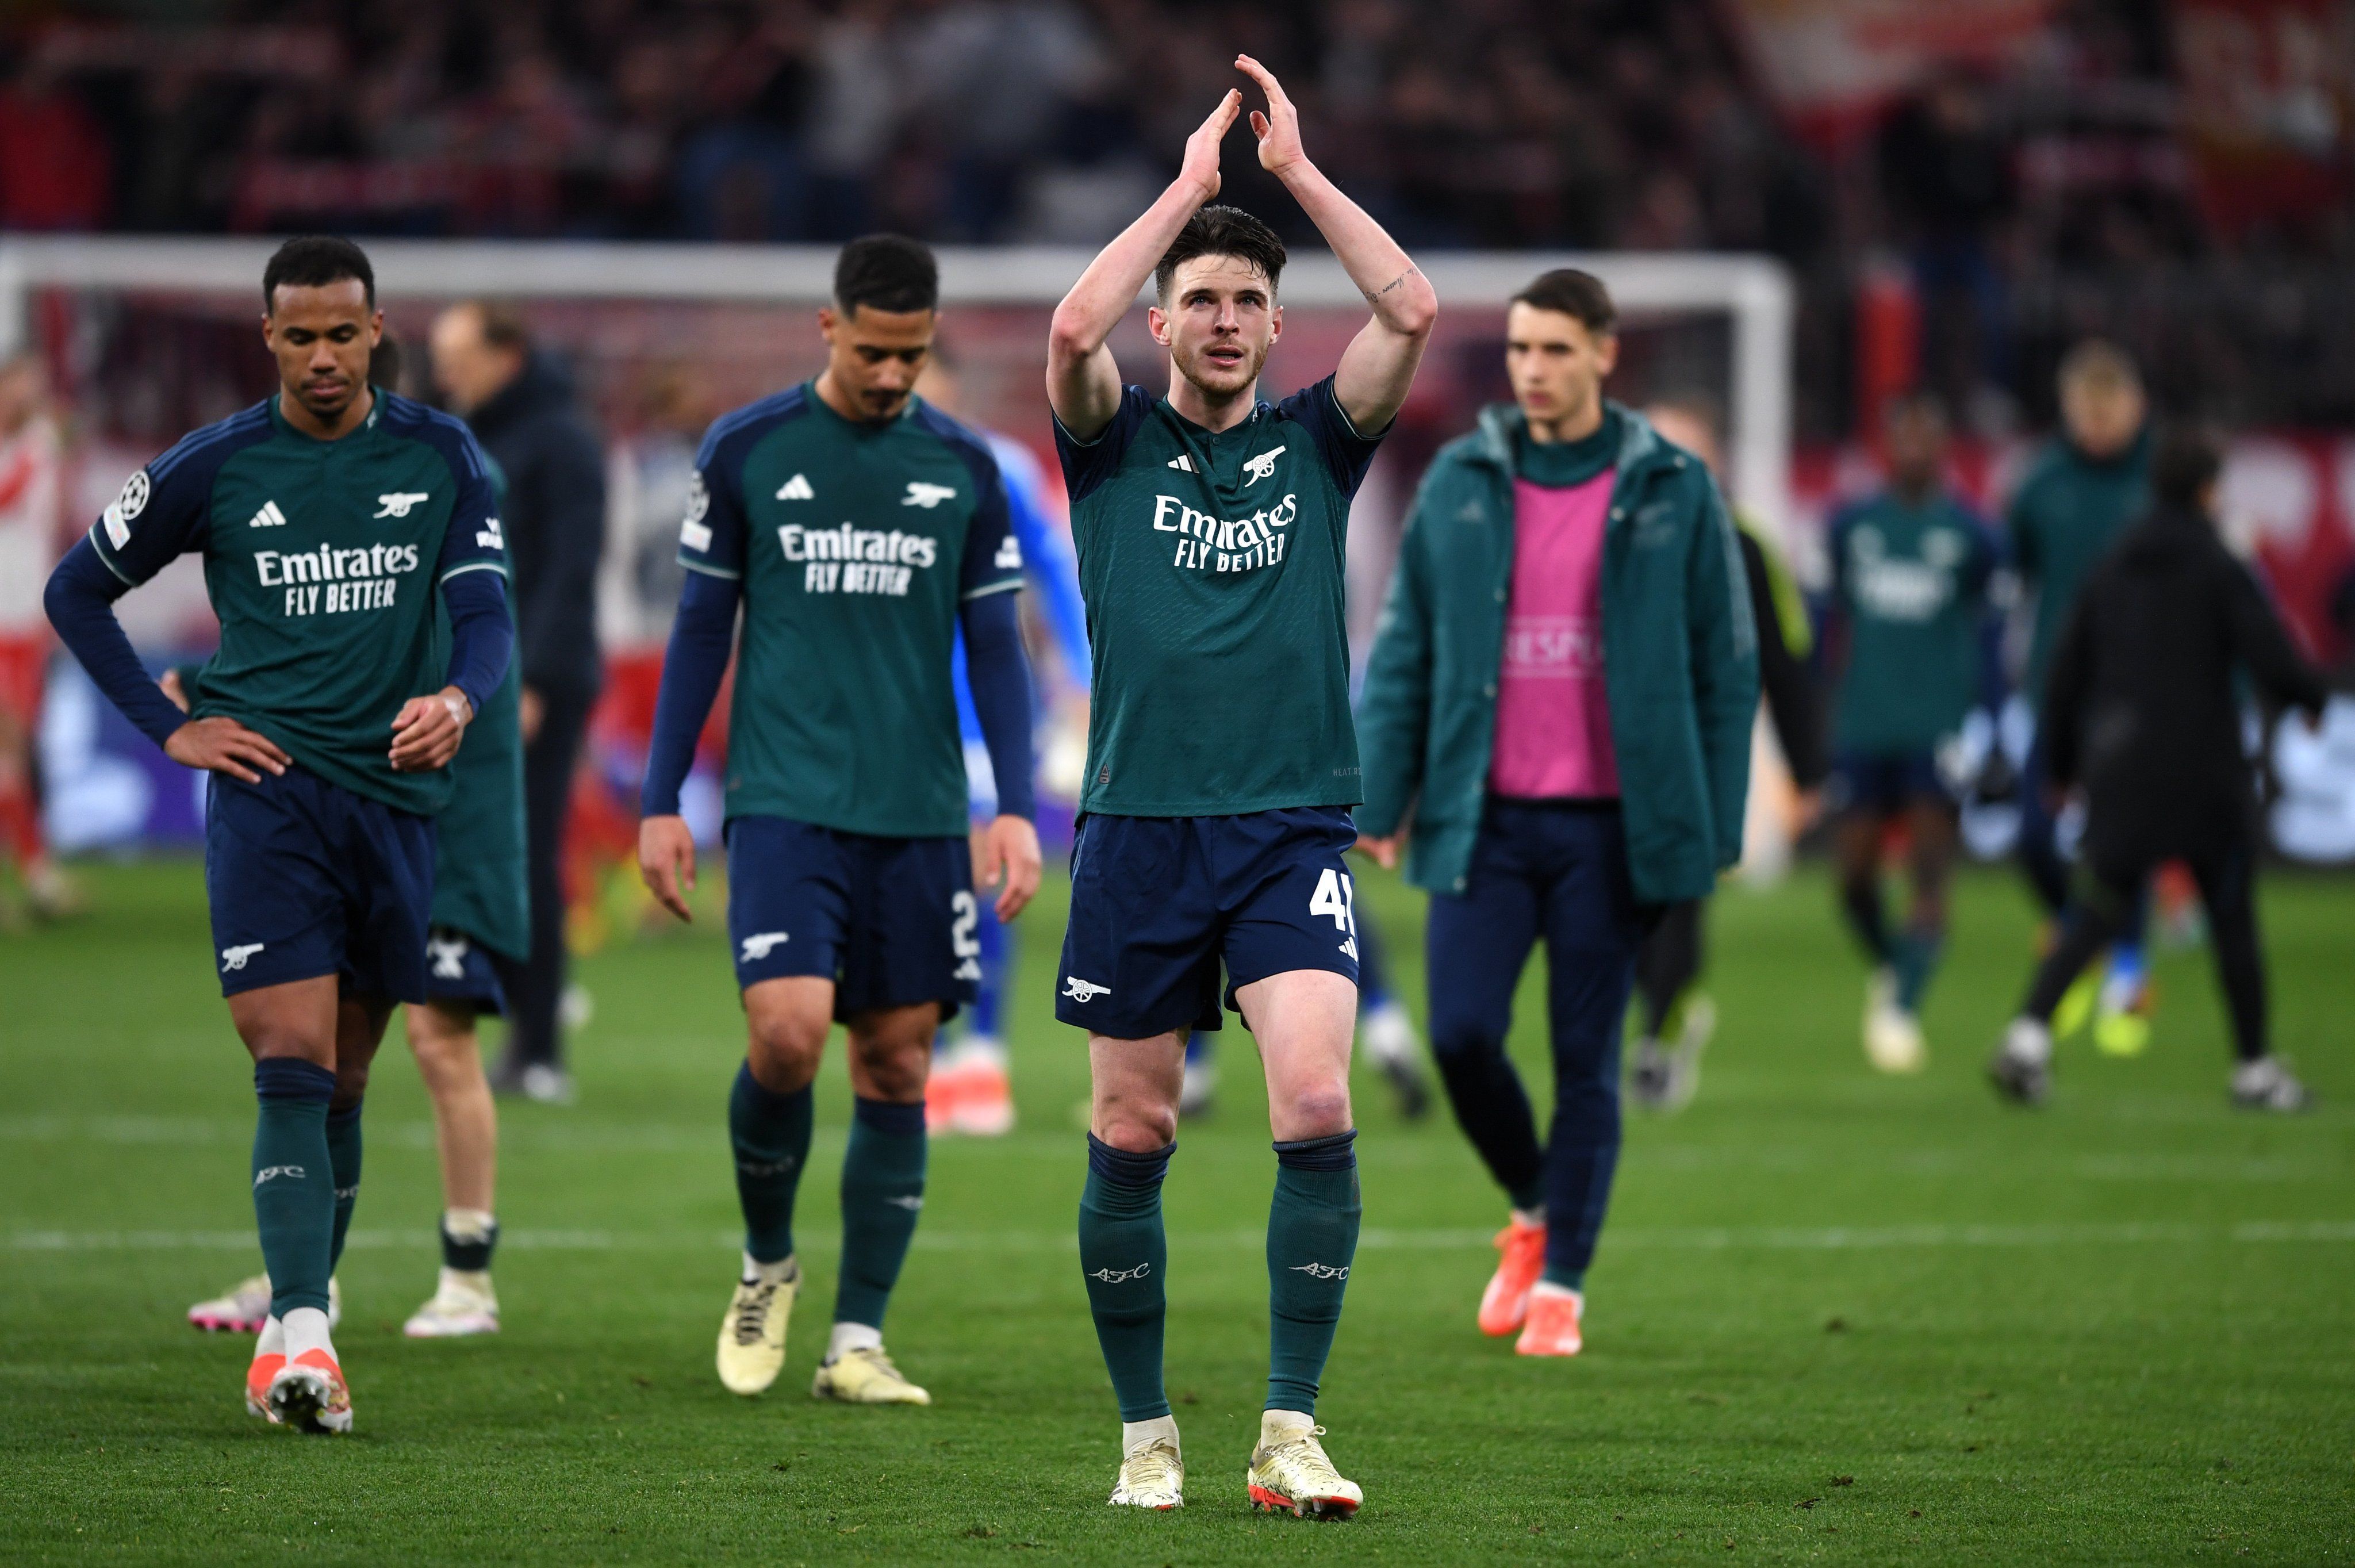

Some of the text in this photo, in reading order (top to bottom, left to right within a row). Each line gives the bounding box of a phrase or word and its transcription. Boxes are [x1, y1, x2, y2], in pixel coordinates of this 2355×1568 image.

[1153, 493, 1296, 550] Emirates
[254, 542, 419, 586] Emirates
[777, 521, 937, 568] Emirates
[1174, 533, 1285, 572] FLY BETTER
[285, 577, 397, 617] FLY BETTER
[806, 561, 912, 597] FLY BETTER
[1333, 768, 1351, 776] HEAT
[1309, 868, 1356, 938] 41
[1088, 1262, 1150, 1283] AFC
[1288, 1262, 1349, 1280] AFC
